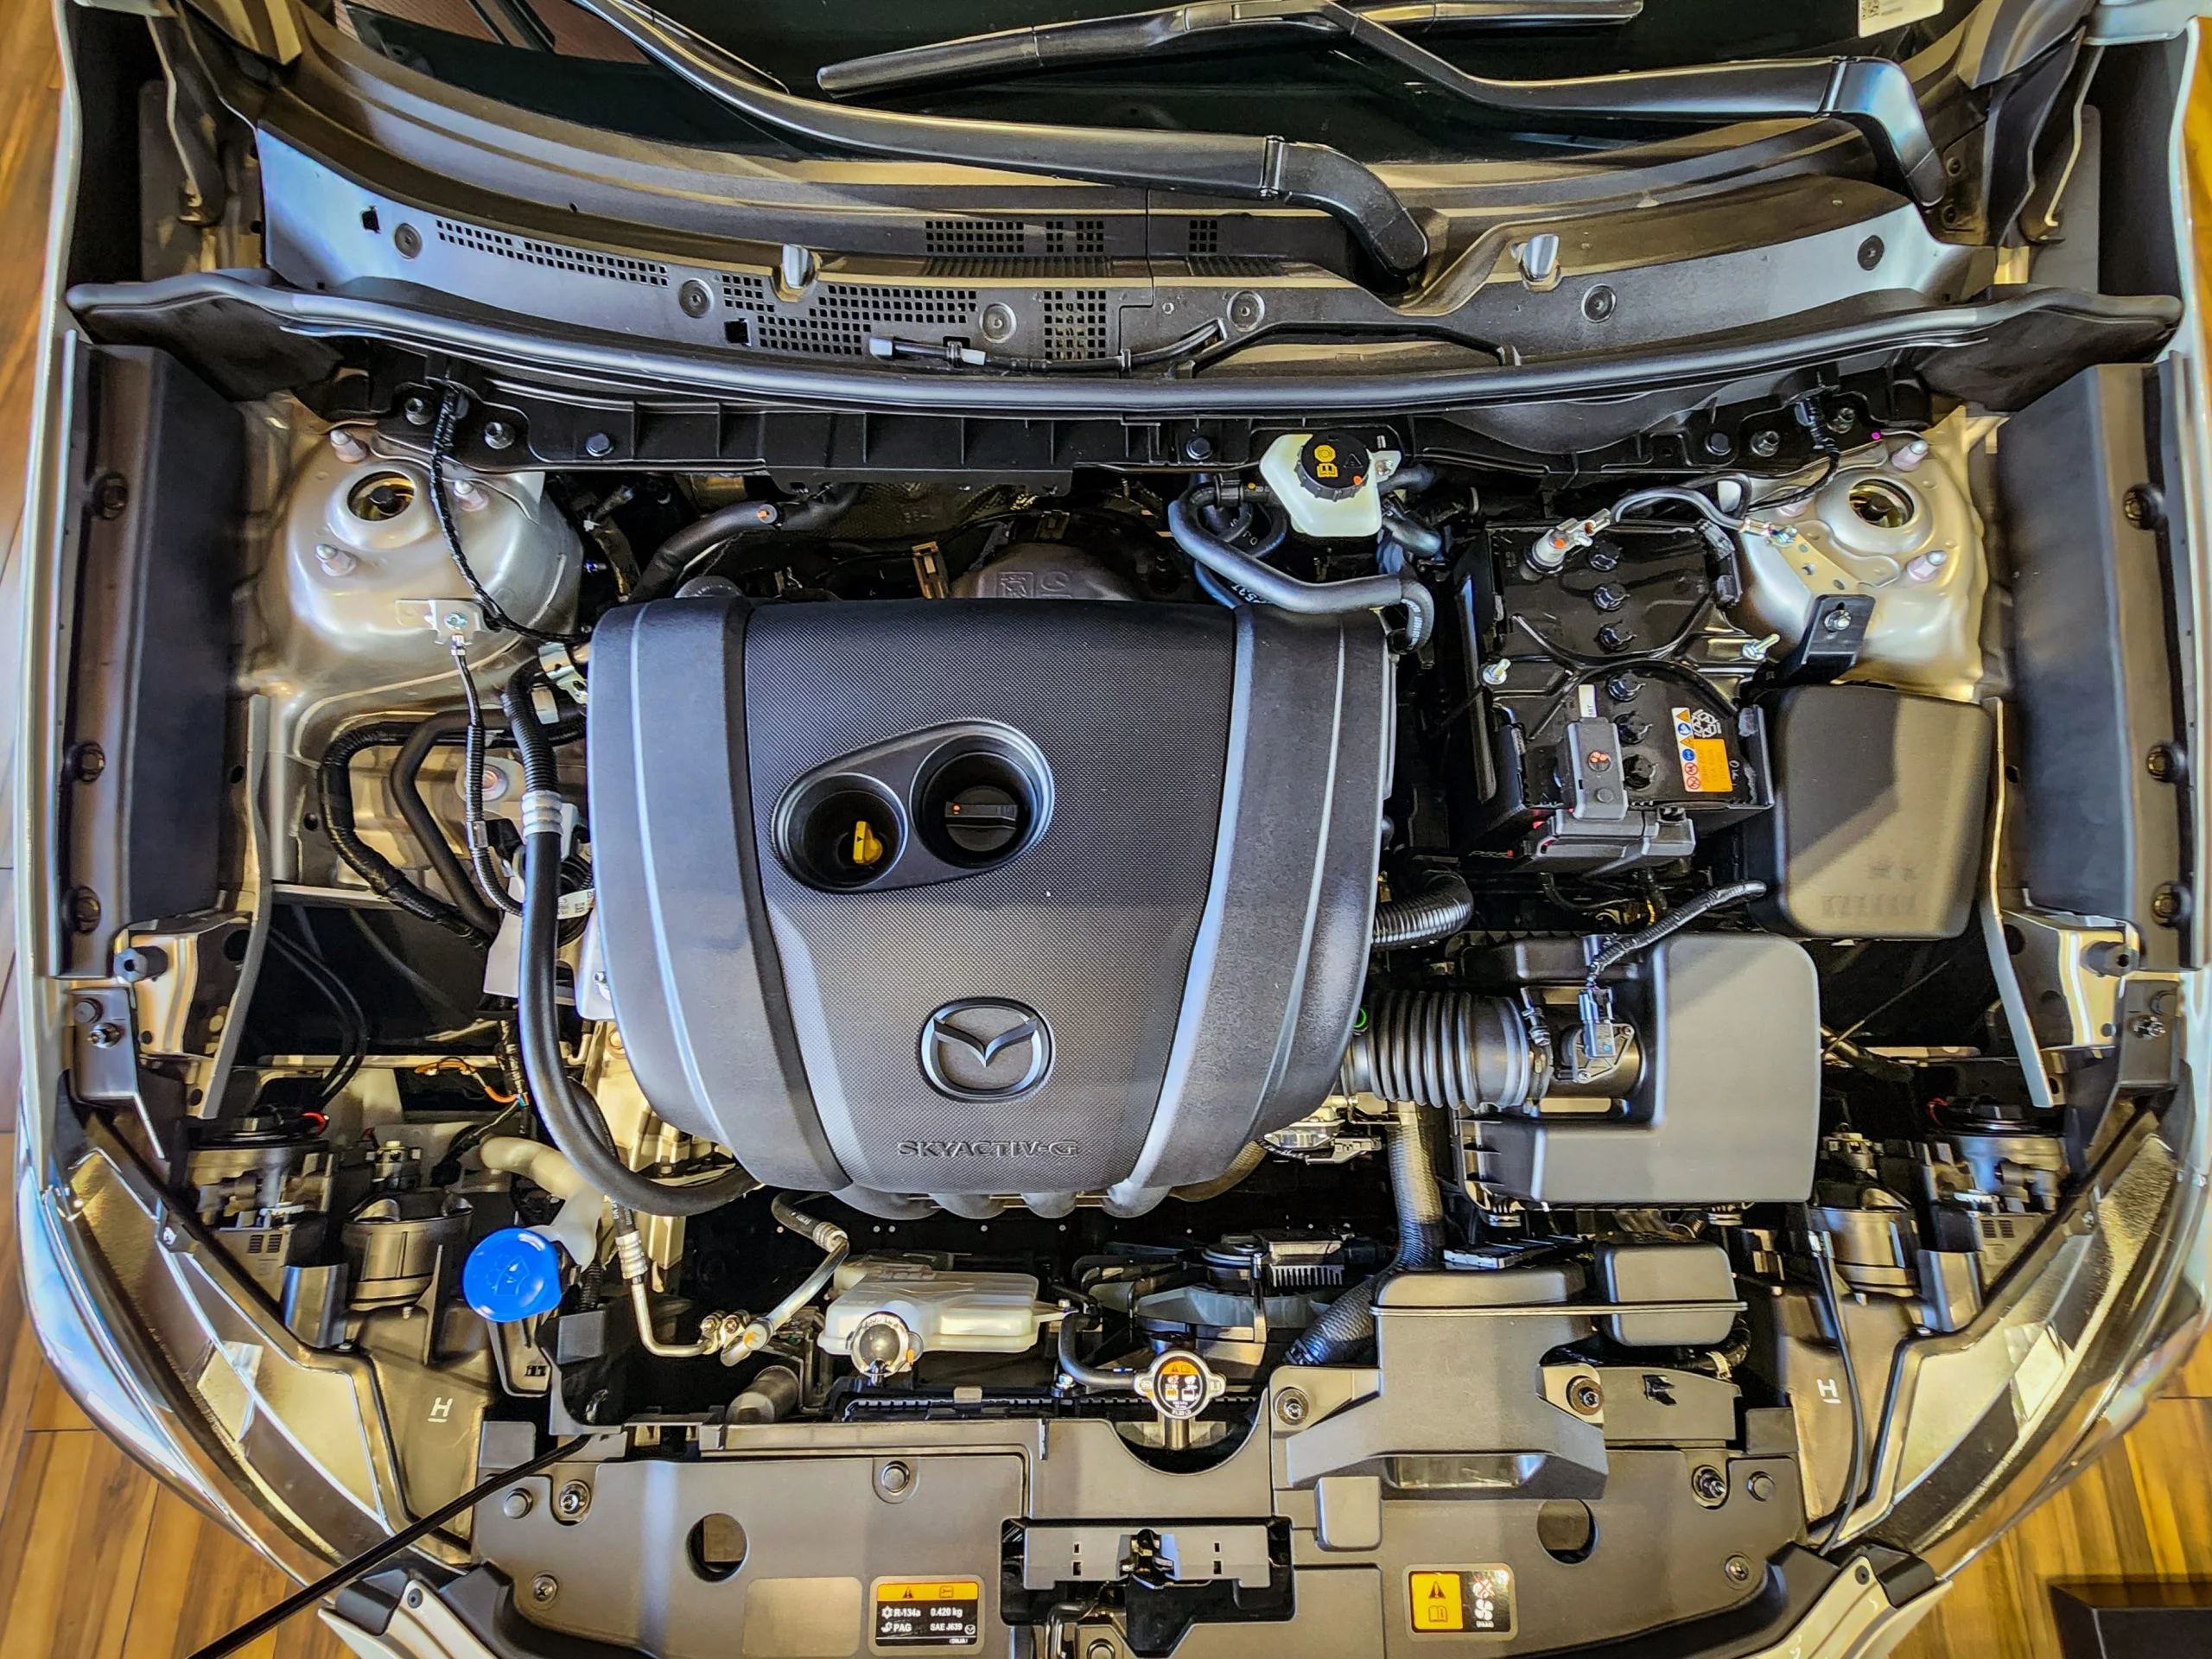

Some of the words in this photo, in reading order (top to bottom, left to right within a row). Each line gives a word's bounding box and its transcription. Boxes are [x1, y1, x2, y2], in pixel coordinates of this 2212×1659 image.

[898, 1141, 1079, 1158] SKYACTIV-G
[952, 1608, 963, 1618] kg
[893, 1624, 912, 1632] PAG
[930, 1623, 945, 1631] SAE
